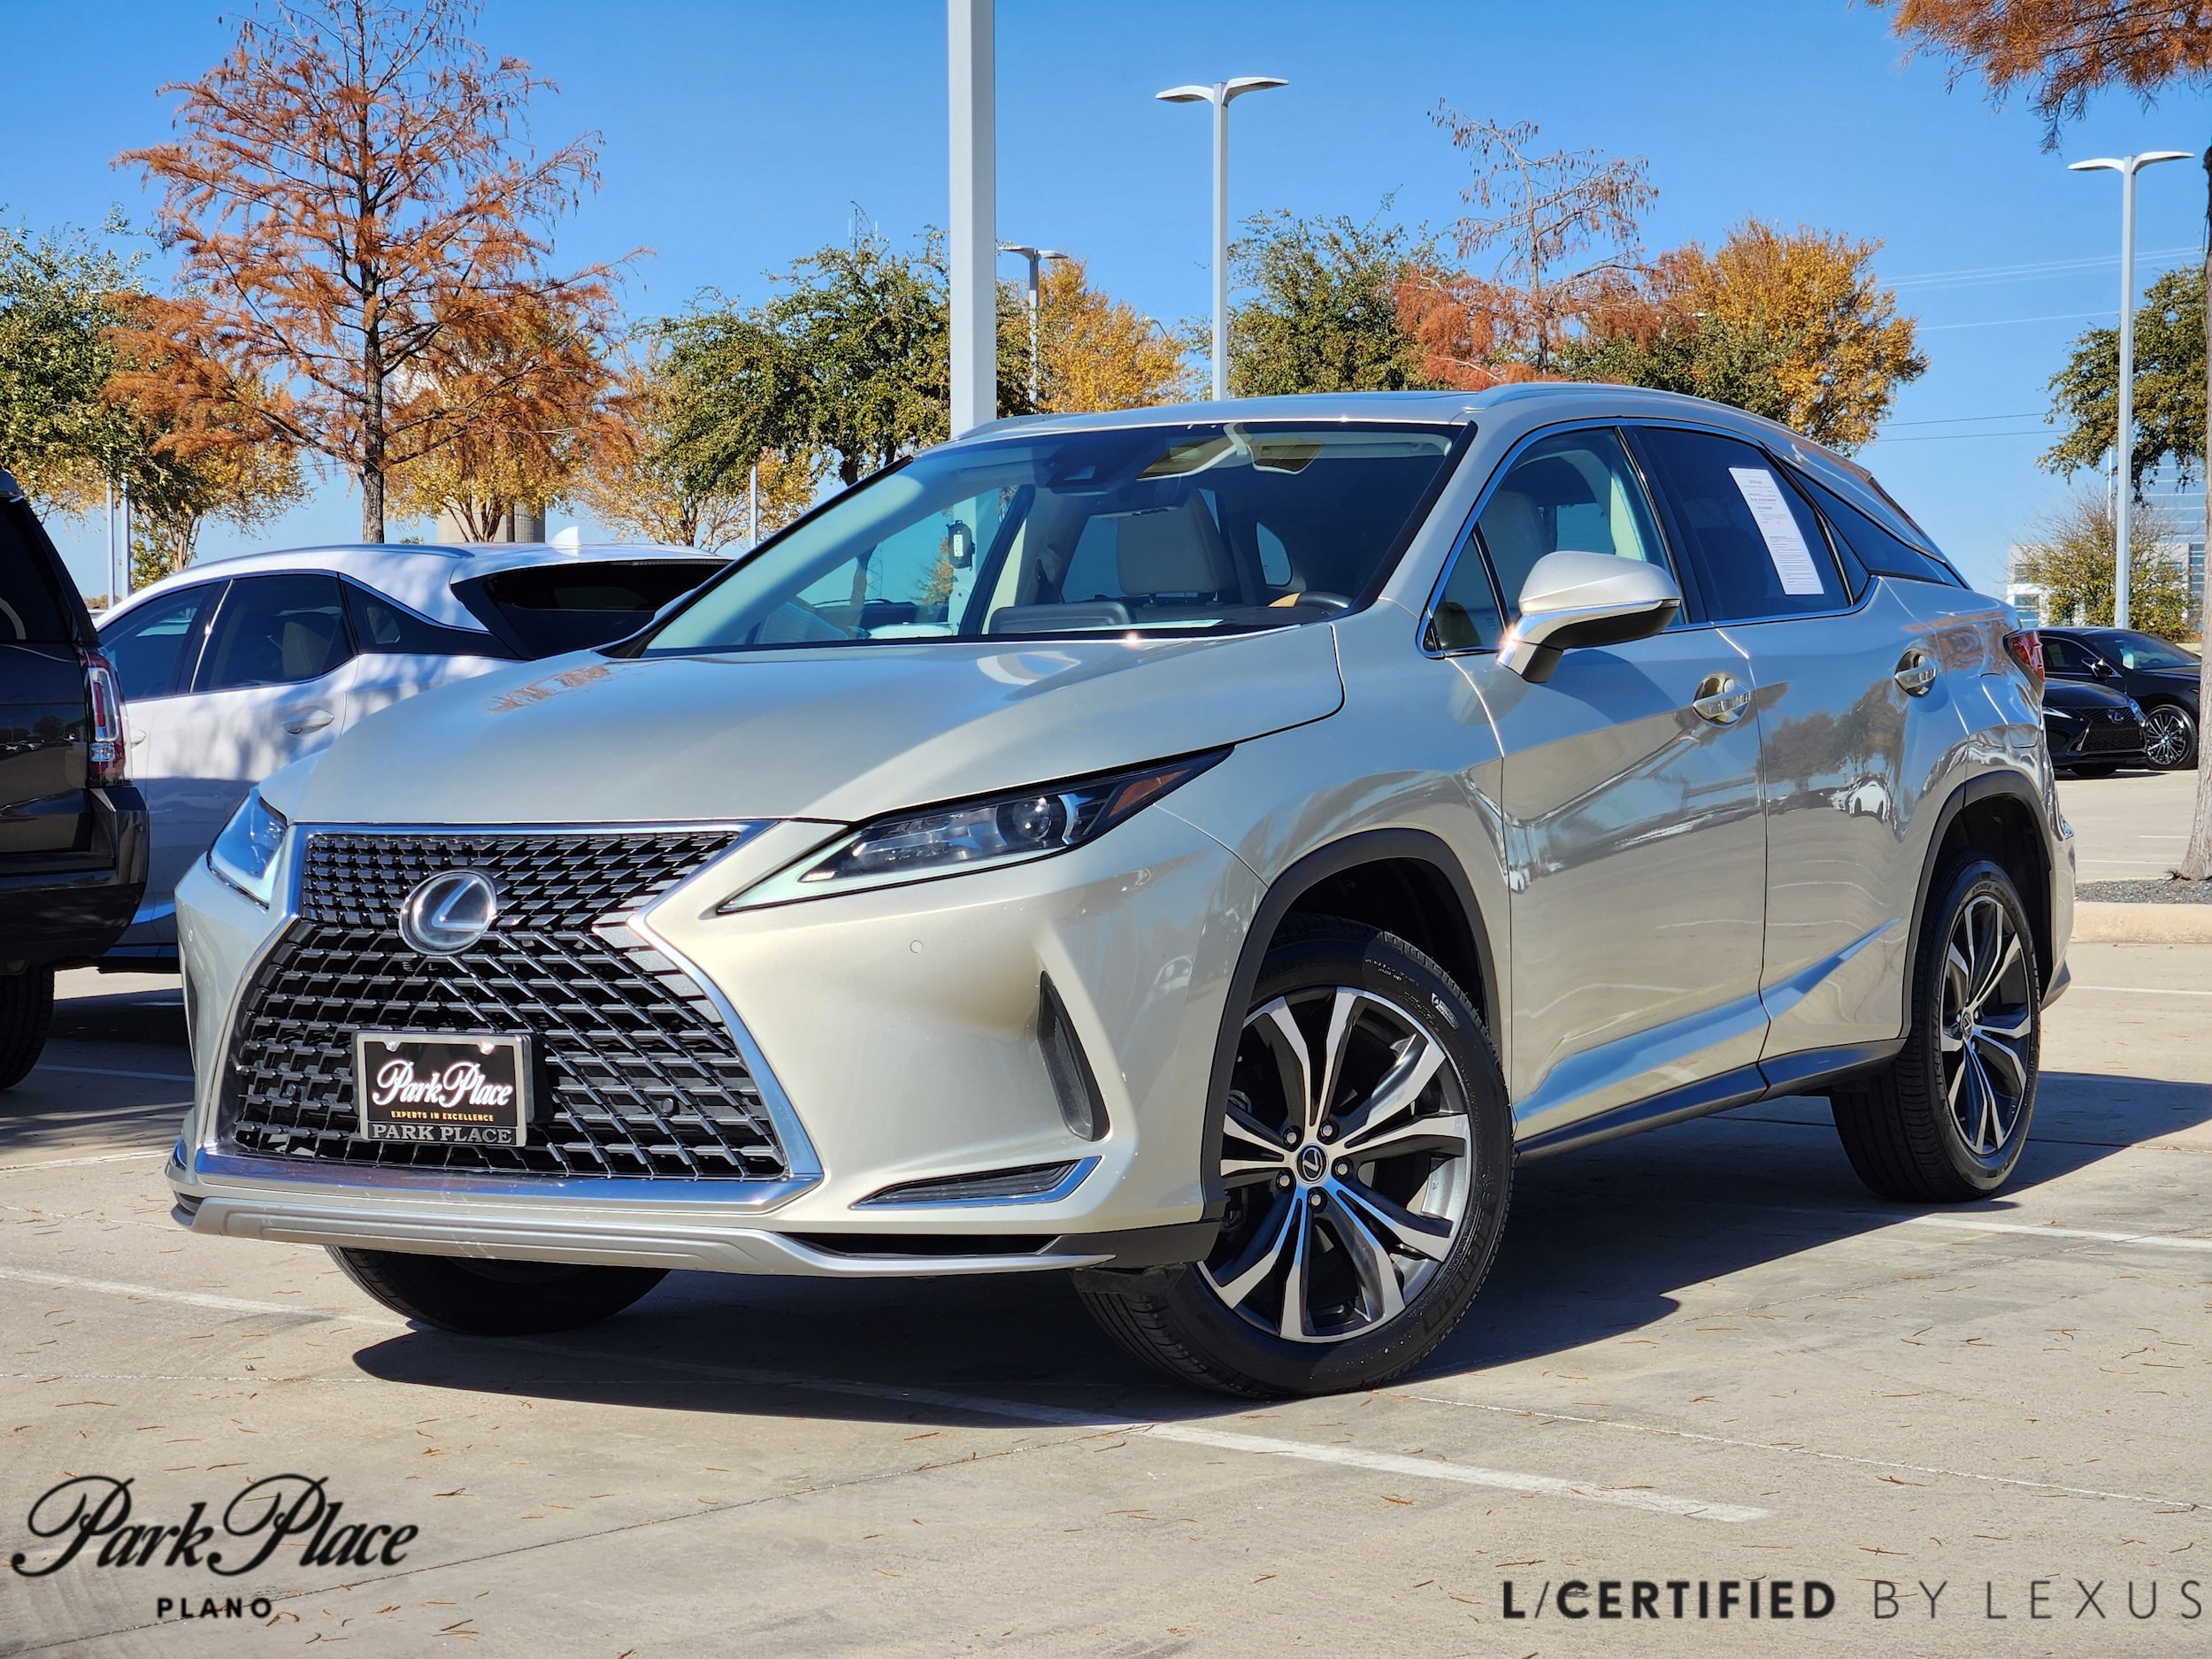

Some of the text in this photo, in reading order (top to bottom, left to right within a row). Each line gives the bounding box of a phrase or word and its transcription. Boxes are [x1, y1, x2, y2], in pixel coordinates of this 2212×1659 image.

[372, 1059, 513, 1108] Park Place
[391, 1110, 427, 1119] EXPERTS
[442, 1112, 494, 1122] EXCELLENCE
[373, 1124, 512, 1144] PARK PLACE
